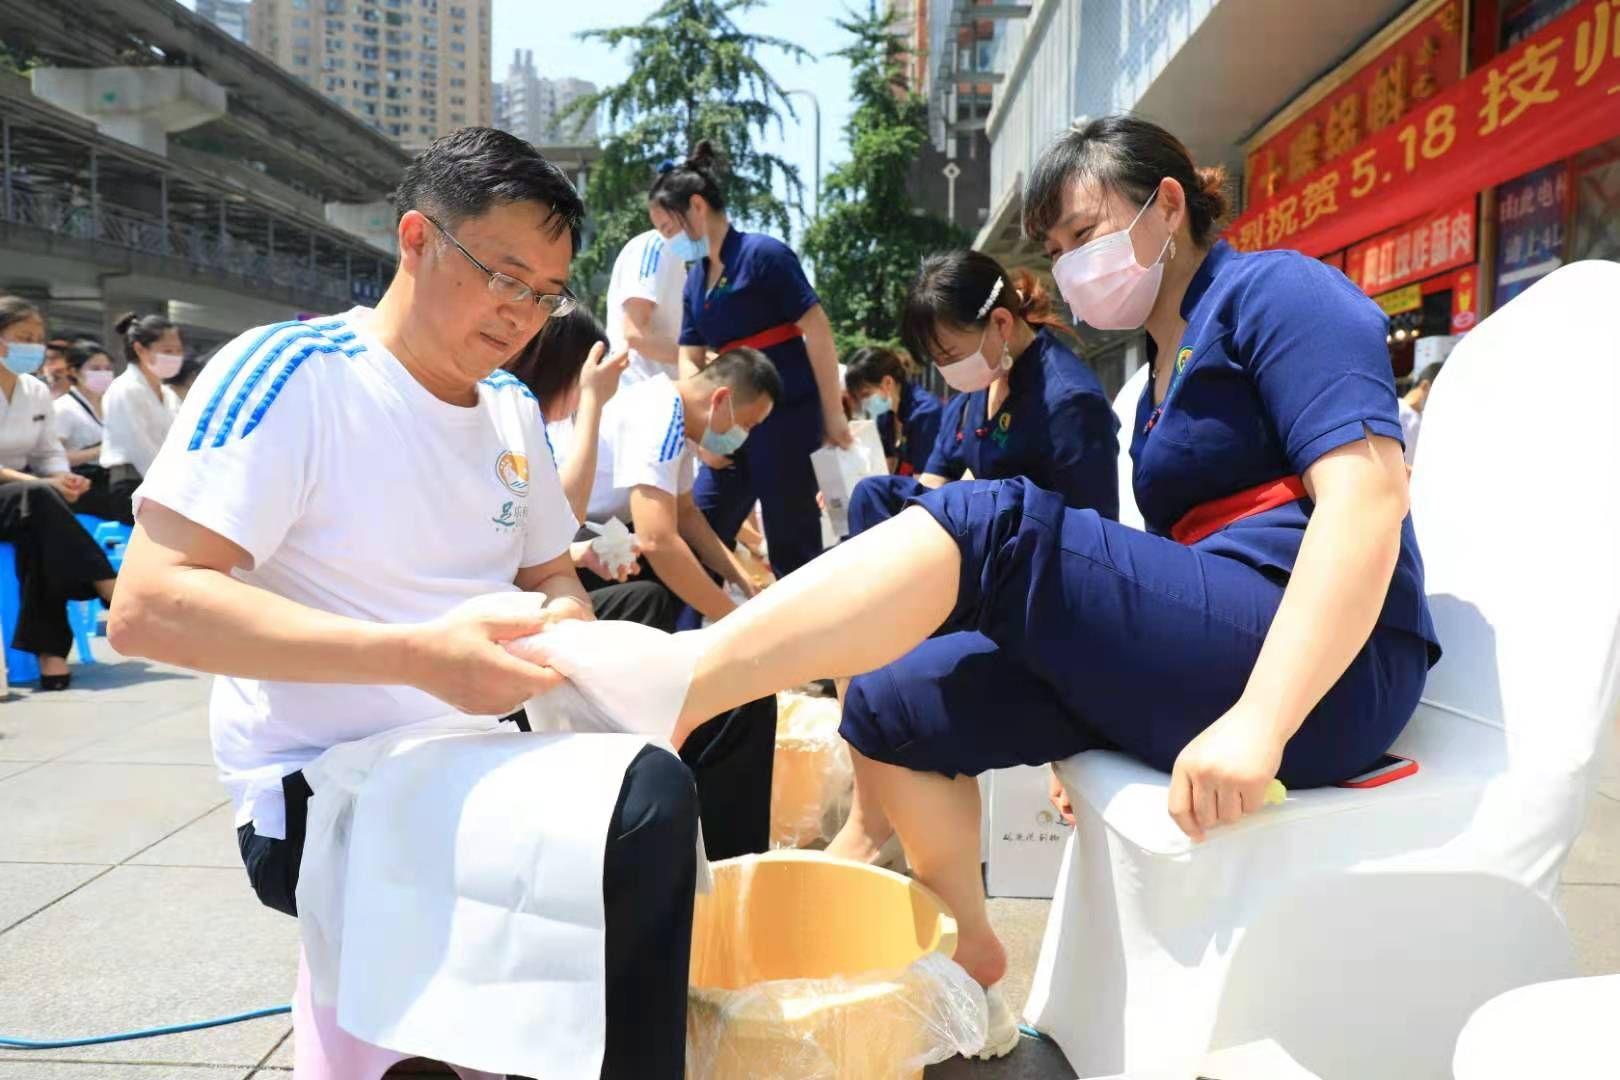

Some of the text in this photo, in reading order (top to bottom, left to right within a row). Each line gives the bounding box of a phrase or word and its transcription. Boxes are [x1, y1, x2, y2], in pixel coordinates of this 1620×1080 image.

[1227, 171, 1339, 253] 烈祝贺
[1351, 104, 1456, 199] 5.18
